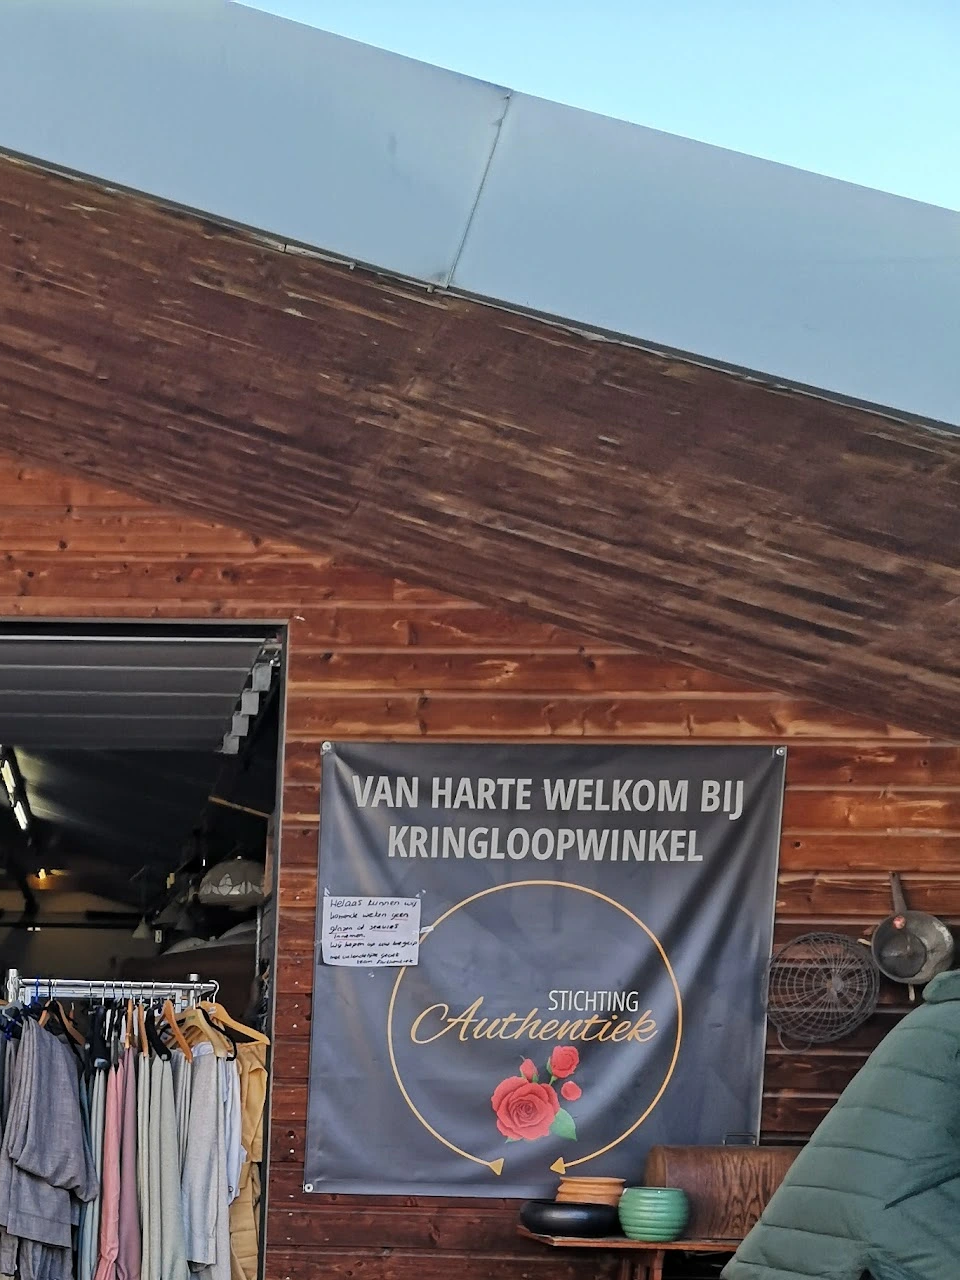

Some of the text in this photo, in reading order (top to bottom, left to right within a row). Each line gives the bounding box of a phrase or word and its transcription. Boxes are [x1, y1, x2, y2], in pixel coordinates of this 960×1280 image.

[352, 775, 744, 820] VAN HARTE WELKOM BIJ
[388, 826, 703, 862] KRINGLOOPWINKEL
[330, 899, 362, 908] Helaas
[548, 990, 639, 1012] STICHTING
[410, 996, 658, 1045] Authentiek
